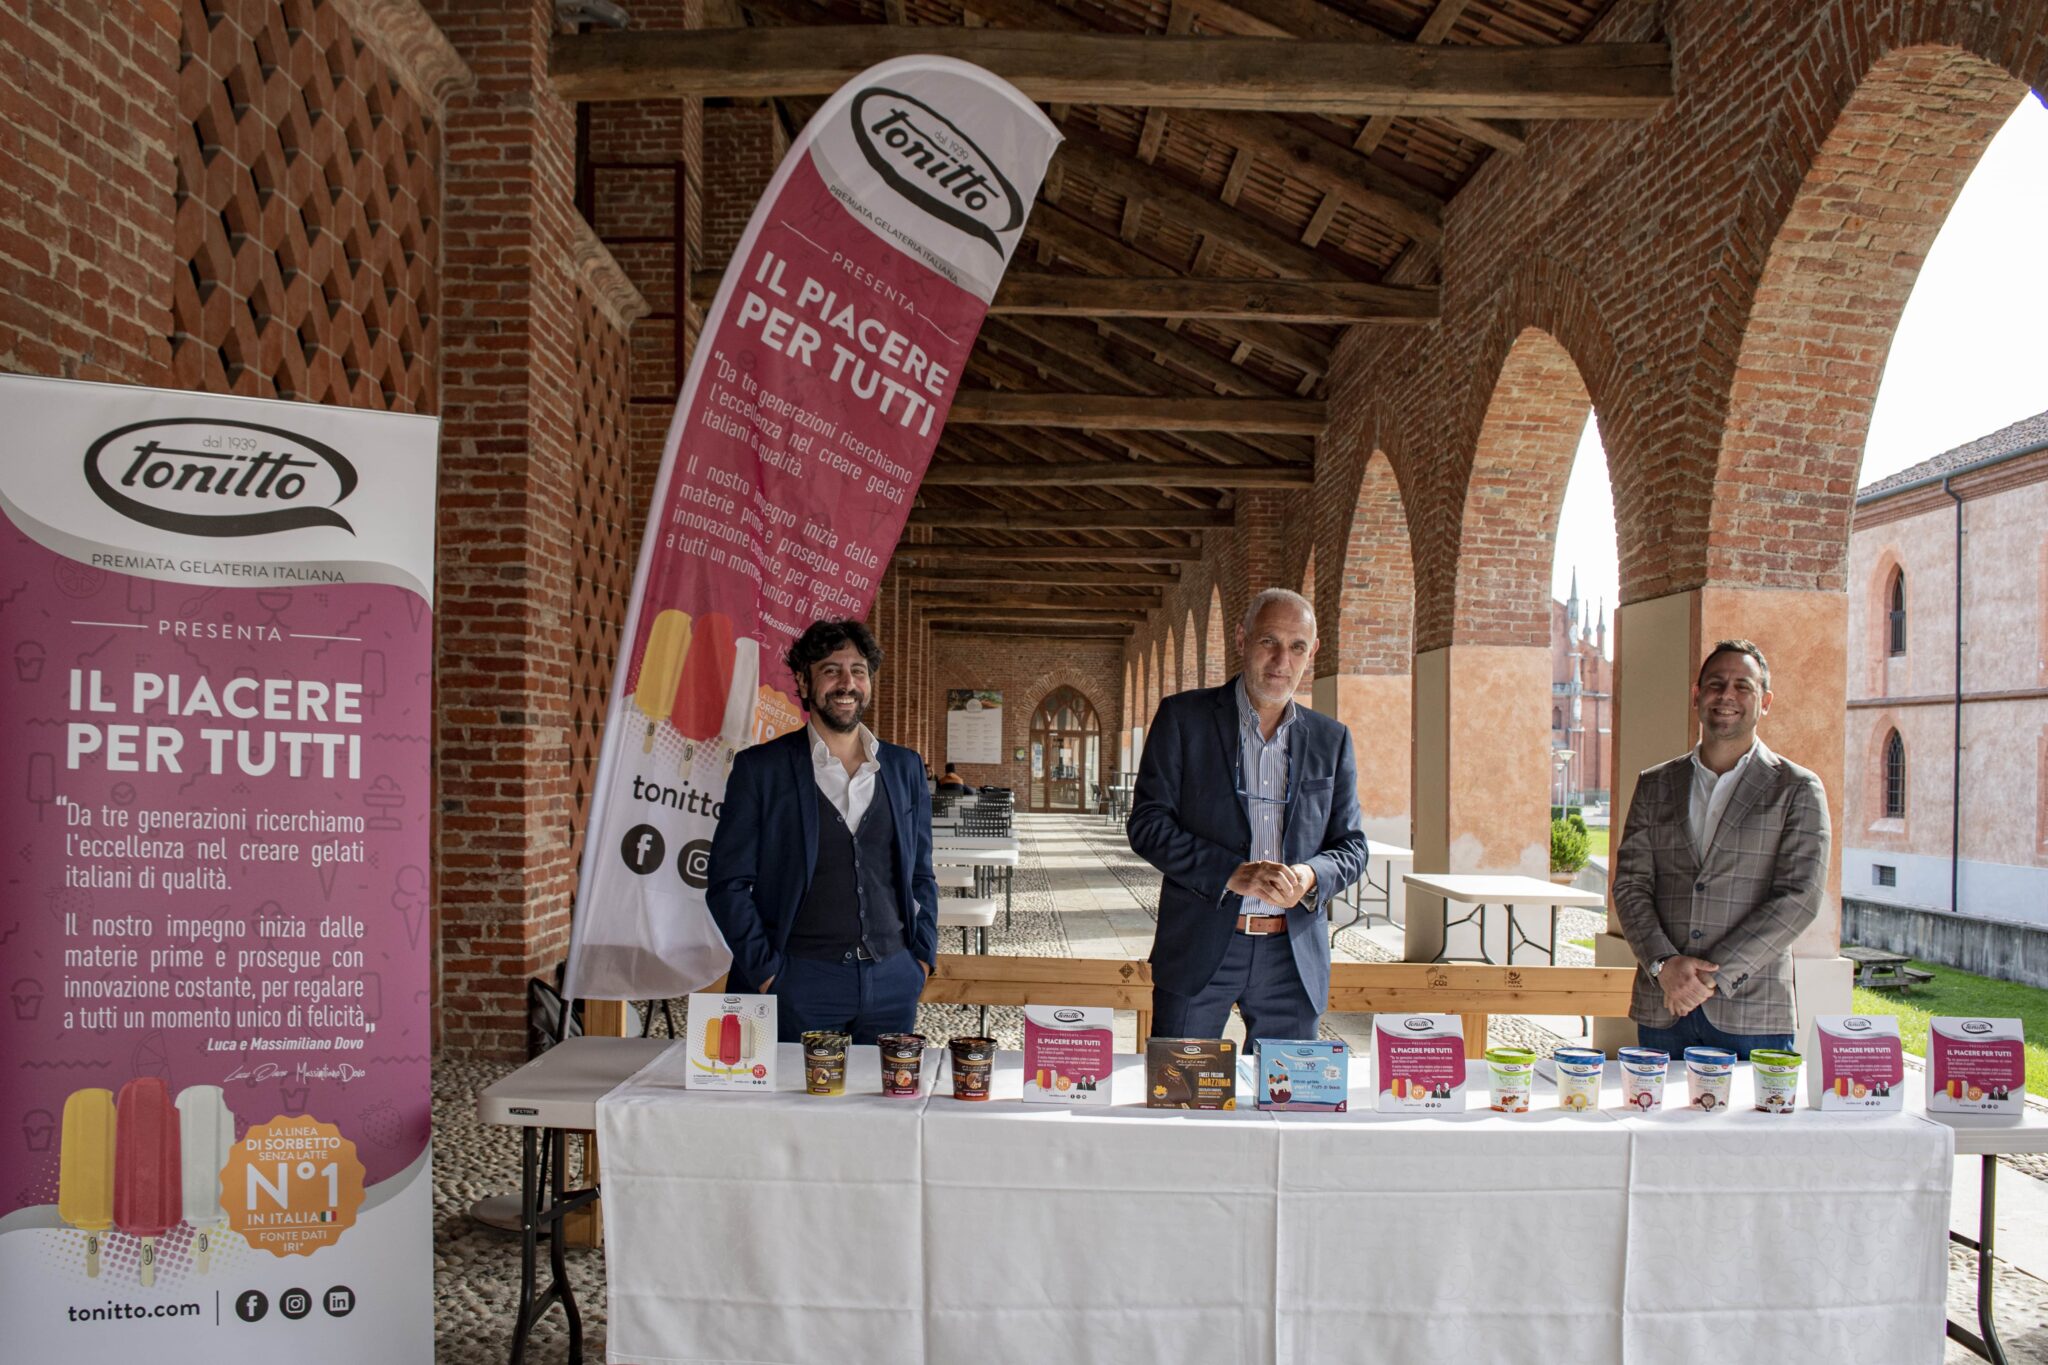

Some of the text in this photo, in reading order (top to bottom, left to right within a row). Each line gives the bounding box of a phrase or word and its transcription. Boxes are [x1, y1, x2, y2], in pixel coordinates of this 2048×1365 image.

[871, 108, 1000, 211] tonitto
[934, 131, 969, 161] dal 1939
[830, 185, 958, 284] PREMIATA GELATERIA ITALIANA
[832, 252, 915, 315] PRESENTA
[755, 251, 950, 397] IL PIACERE
[736, 292, 936, 437] PER TUTTI
[701, 406, 751, 443] italiani
[742, 372, 758, 395] tre
[759, 389, 839, 439] generazioni
[840, 430, 913, 484] ricerchiamo
[202, 434, 257, 452] dal 1939
[120, 440, 317, 500] tonitto
[789, 432, 814, 455] nel
[818, 447, 862, 480] creare
[865, 474, 905, 506] gelati
[707, 464, 750, 496] nostro
[803, 518, 839, 549] inizia
[844, 541, 878, 569] dalle
[679, 483, 735, 515] materie
[764, 529, 773, 544] e
[777, 537, 840, 577] prosegue
[845, 570, 869, 591] con
[91, 552, 345, 583] PREMIATA GELATERIA ITALIANA
[673, 504, 861, 614] innovazione conte, per regalare
[666, 533, 675, 549] a
[678, 533, 710, 558] tutti
[710, 547, 725, 565] un
[762, 585, 793, 607] unico
[795, 594, 808, 617] di
[810, 602, 847, 623] felic
[158, 620, 282, 642] PRESENTA
[762, 611, 805, 638] Massimili
[69, 668, 362, 723] IL PIACERE
[760, 700, 799, 726] ORBETTO
[66, 722, 361, 779] PER TUTTI
[101, 804, 129, 827] tre
[138, 807, 247, 834] generazioni
[255, 809, 365, 833] ricerchiamo
[197, 837, 228, 860] nel
[239, 843, 300, 862] creare
[311, 839, 365, 867] gelati
[65, 864, 232, 895] italiani di qualità.
[65, 912, 364, 943] Il nostro impegno inizia dalle
[65, 945, 364, 973] materie prime e prosegue con
[64, 975, 364, 1003] innovazione costante, per regalare
[63, 1011, 74, 1029] a
[80, 1006, 117, 1028] tutti
[123, 1010, 145, 1028] un
[151, 1006, 230, 1028] momento
[236, 1005, 281, 1027] unico
[287, 1004, 302, 1027] di
[207, 1037, 364, 1051] Luca e Massimiliano Dovo
[246, 1137, 341, 1151] DI SORBETTO
[269, 1127, 318, 1137] LA LINEA
[259, 1151, 328, 1161] SENZA LATTE
[248, 1212, 319, 1226] IN ITALIA
[259, 1230, 327, 1242] FONTE DATI
[68, 1300, 200, 1322] tonitto.com
